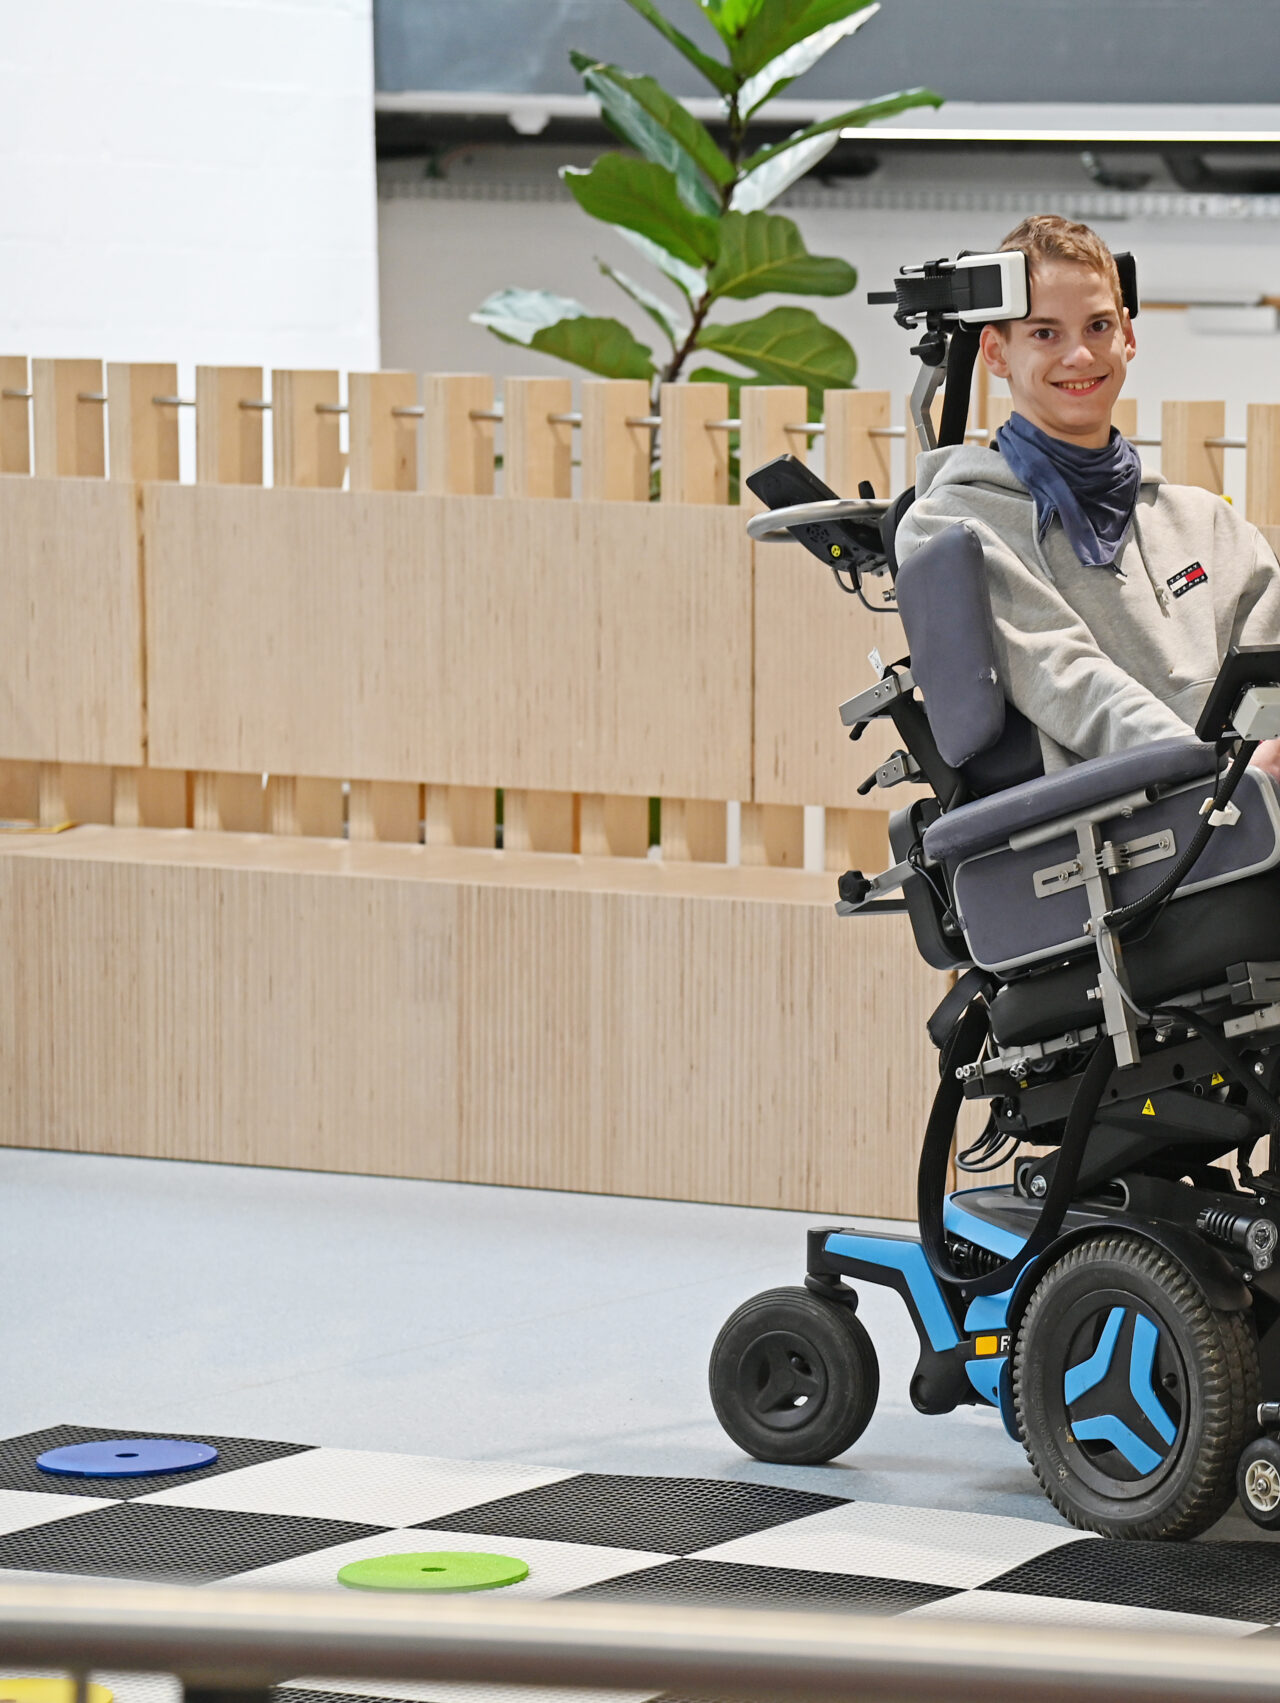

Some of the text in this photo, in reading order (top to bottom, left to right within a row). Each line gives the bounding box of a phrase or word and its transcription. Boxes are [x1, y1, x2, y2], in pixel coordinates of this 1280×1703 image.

[1169, 564, 1198, 584] TOMMY
[1177, 575, 1205, 595] JEANS
[1000, 1335, 1010, 1352] F
